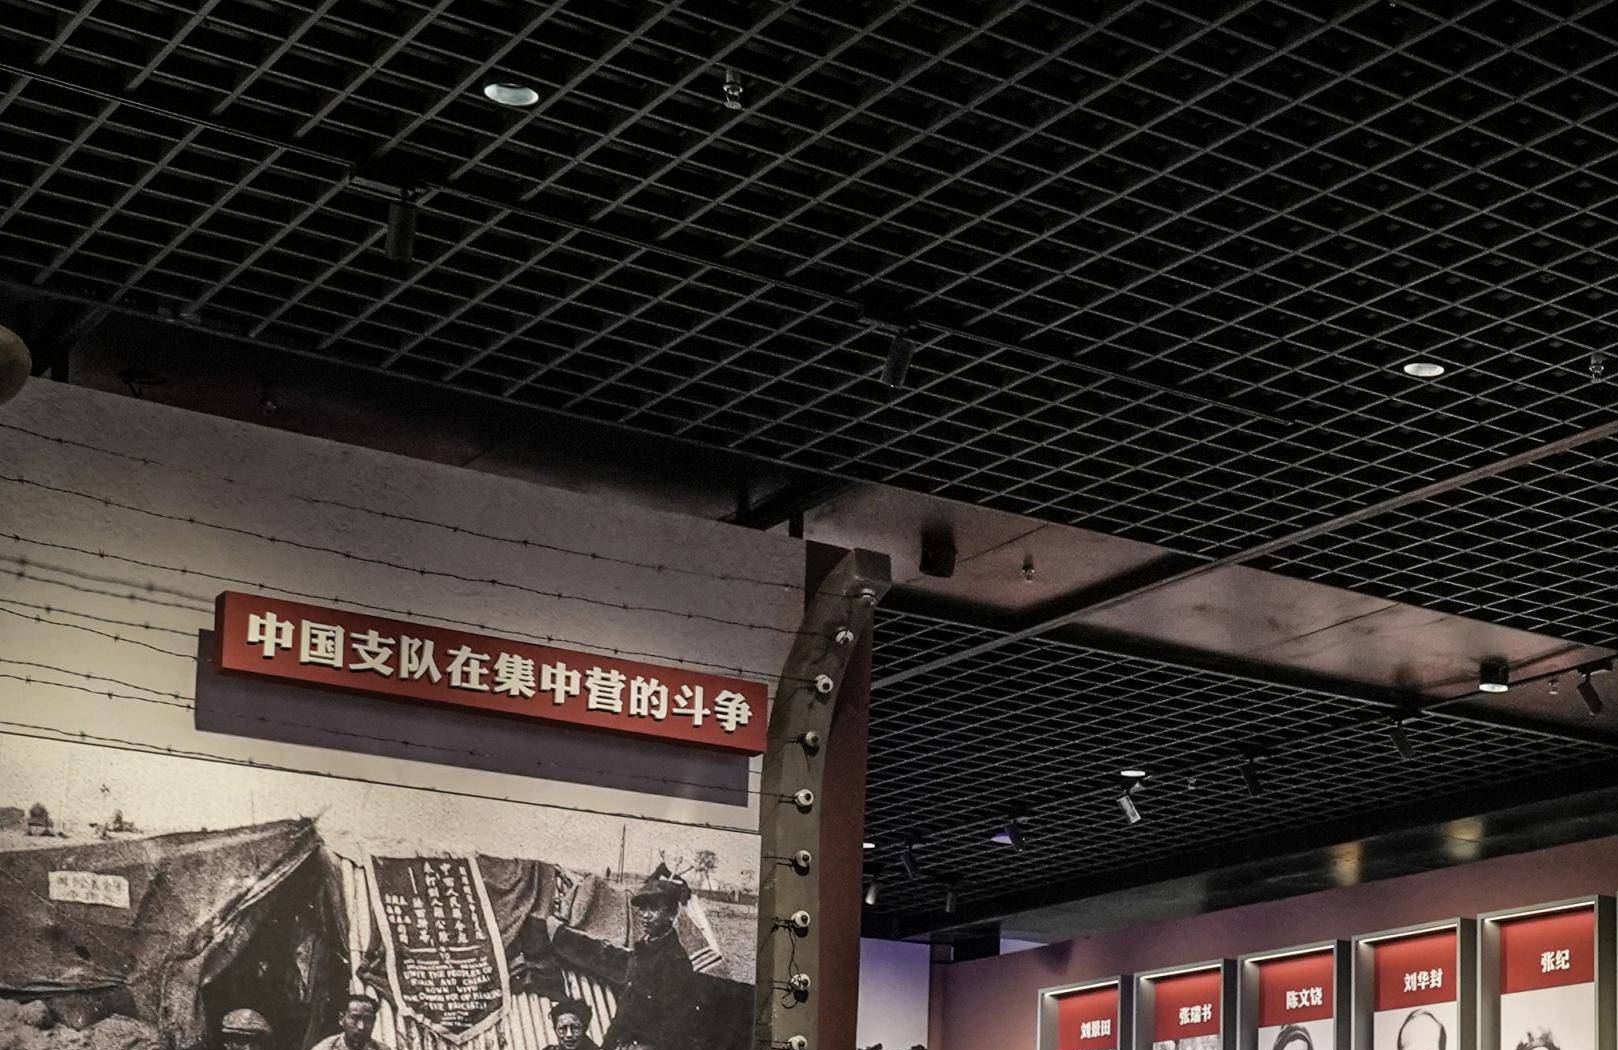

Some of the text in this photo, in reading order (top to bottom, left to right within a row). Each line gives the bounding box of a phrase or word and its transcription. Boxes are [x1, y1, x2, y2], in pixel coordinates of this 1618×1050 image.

[247, 611, 753, 732] 中国支队在集中营的斗争
[1540, 949, 1571, 973] 张纪
[1403, 968, 1444, 992] 刘华封
[1285, 986, 1323, 1010] 陈文饶
[1178, 1003, 1213, 1026] 张瑞书
[1080, 1019, 1112, 1040] 刘景田
